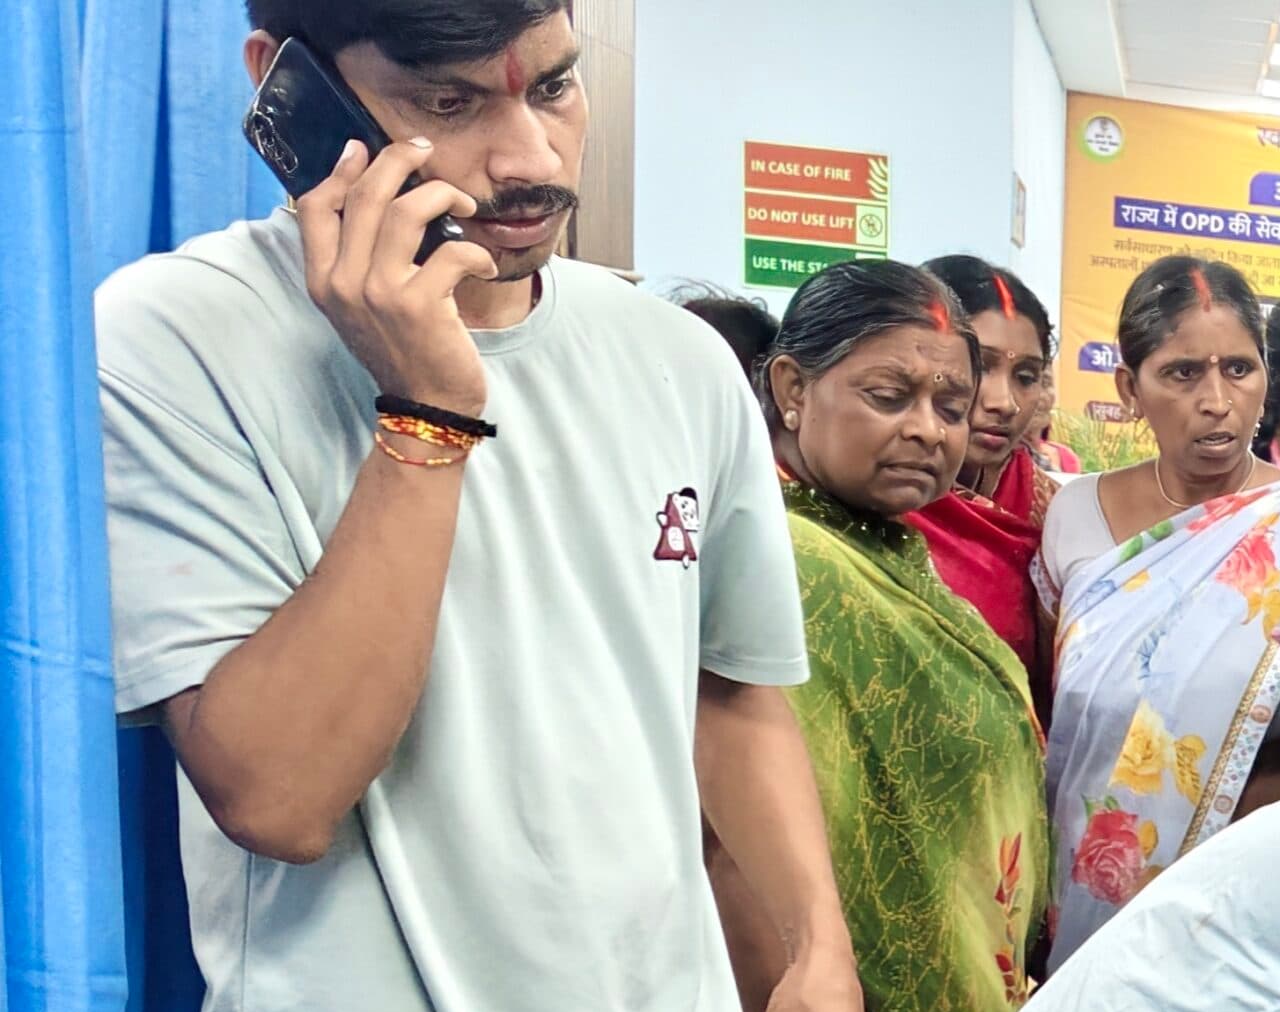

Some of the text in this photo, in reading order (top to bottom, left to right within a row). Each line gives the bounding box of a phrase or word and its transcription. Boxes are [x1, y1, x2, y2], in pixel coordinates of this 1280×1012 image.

[751, 159, 852, 181] IN CASE OF FIRE
[747, 207, 855, 230] DO NOT USE LIFT
[1121, 204, 1160, 226] राज्य
[1163, 204, 1178, 229] में
[1181, 212, 1224, 233] OPD
[1228, 212, 1252, 237] की
[752, 256, 777, 269] USE
[780, 258, 805, 273] THE
